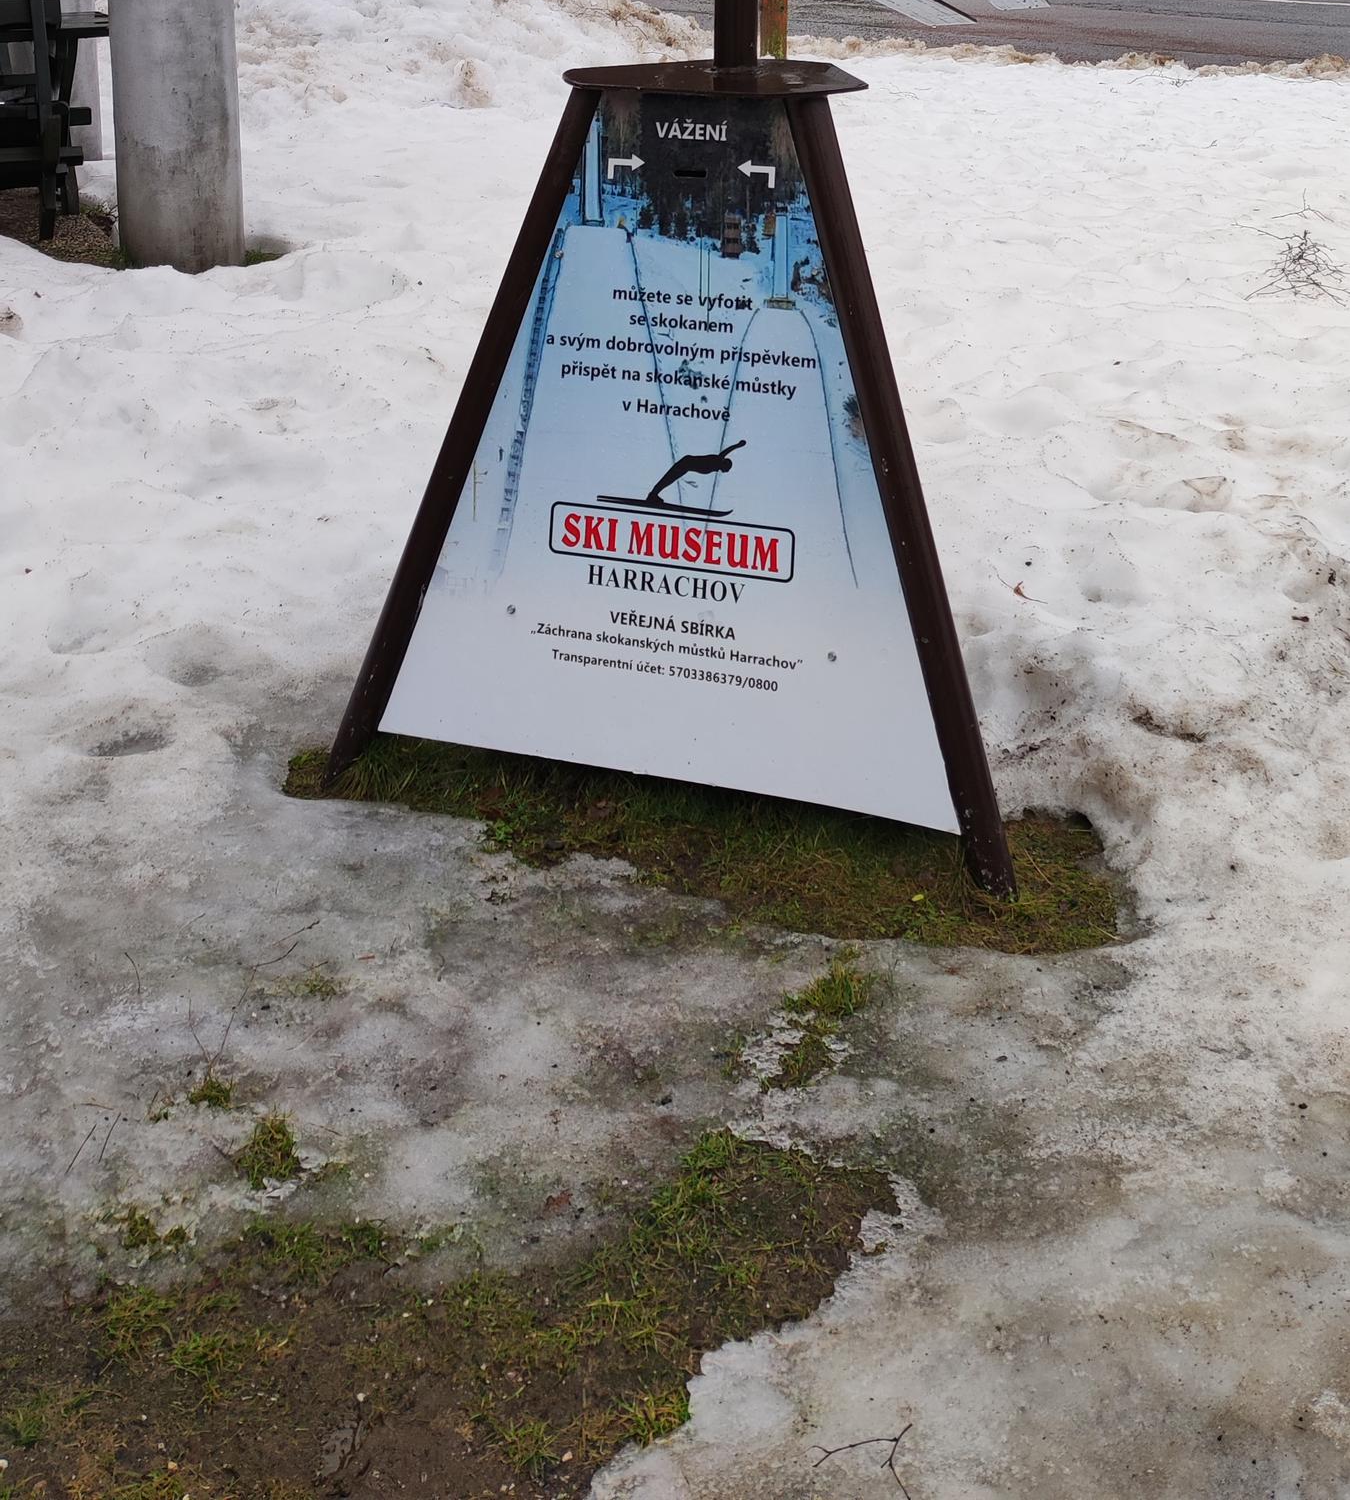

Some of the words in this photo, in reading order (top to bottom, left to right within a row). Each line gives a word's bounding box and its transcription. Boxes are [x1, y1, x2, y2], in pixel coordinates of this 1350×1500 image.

[655, 118, 728, 143] VÁŽENÍ
[613, 285, 671, 304] můžete
[676, 293, 693, 306] se
[698, 293, 753, 311] vyfotit
[629, 313, 647, 326] se
[651, 312, 734, 334] skokanem
[546, 333, 555, 345] a
[559, 333, 601, 351] svým
[606, 335, 715, 362] dobrovolným
[561, 360, 617, 381] přispět
[622, 369, 641, 382] na
[645, 368, 731, 390] skokanské
[735, 376, 797, 401] můstky
[622, 400, 632, 412] v
[636, 398, 731, 423] Harrachově
[561, 512, 619, 552] SKI
[627, 519, 780, 574] MUSEUM
[587, 563, 746, 604] HARRACHOV
[609, 609, 676, 632] VEŘEJNÁ
[680, 619, 736, 641] SBÍRKA
[595, 631, 675, 653] skokanských
[678, 642, 726, 660] můstků
[551, 648, 633, 671] Transparentní
[636, 660, 666, 676] účet:
[668, 665, 779, 692] 5703386379/0800
